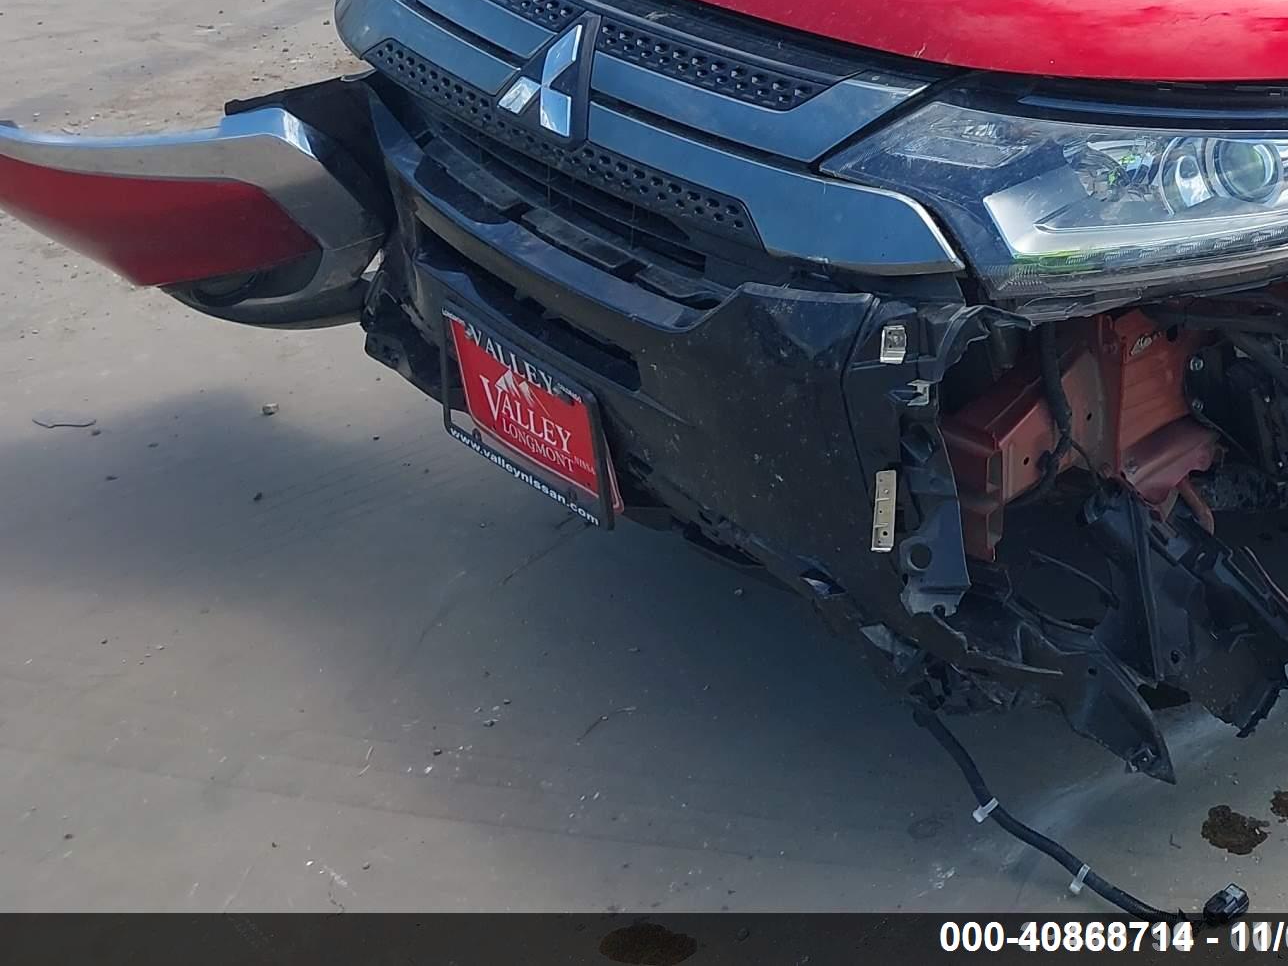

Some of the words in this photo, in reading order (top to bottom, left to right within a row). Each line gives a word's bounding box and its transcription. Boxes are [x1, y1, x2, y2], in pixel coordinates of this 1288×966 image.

[468, 323, 554, 396] VALLEY
[480, 375, 571, 454] VALLEY
[502, 418, 575, 472] LONGMONT
[451, 427, 600, 527] www.valleynissan.com
